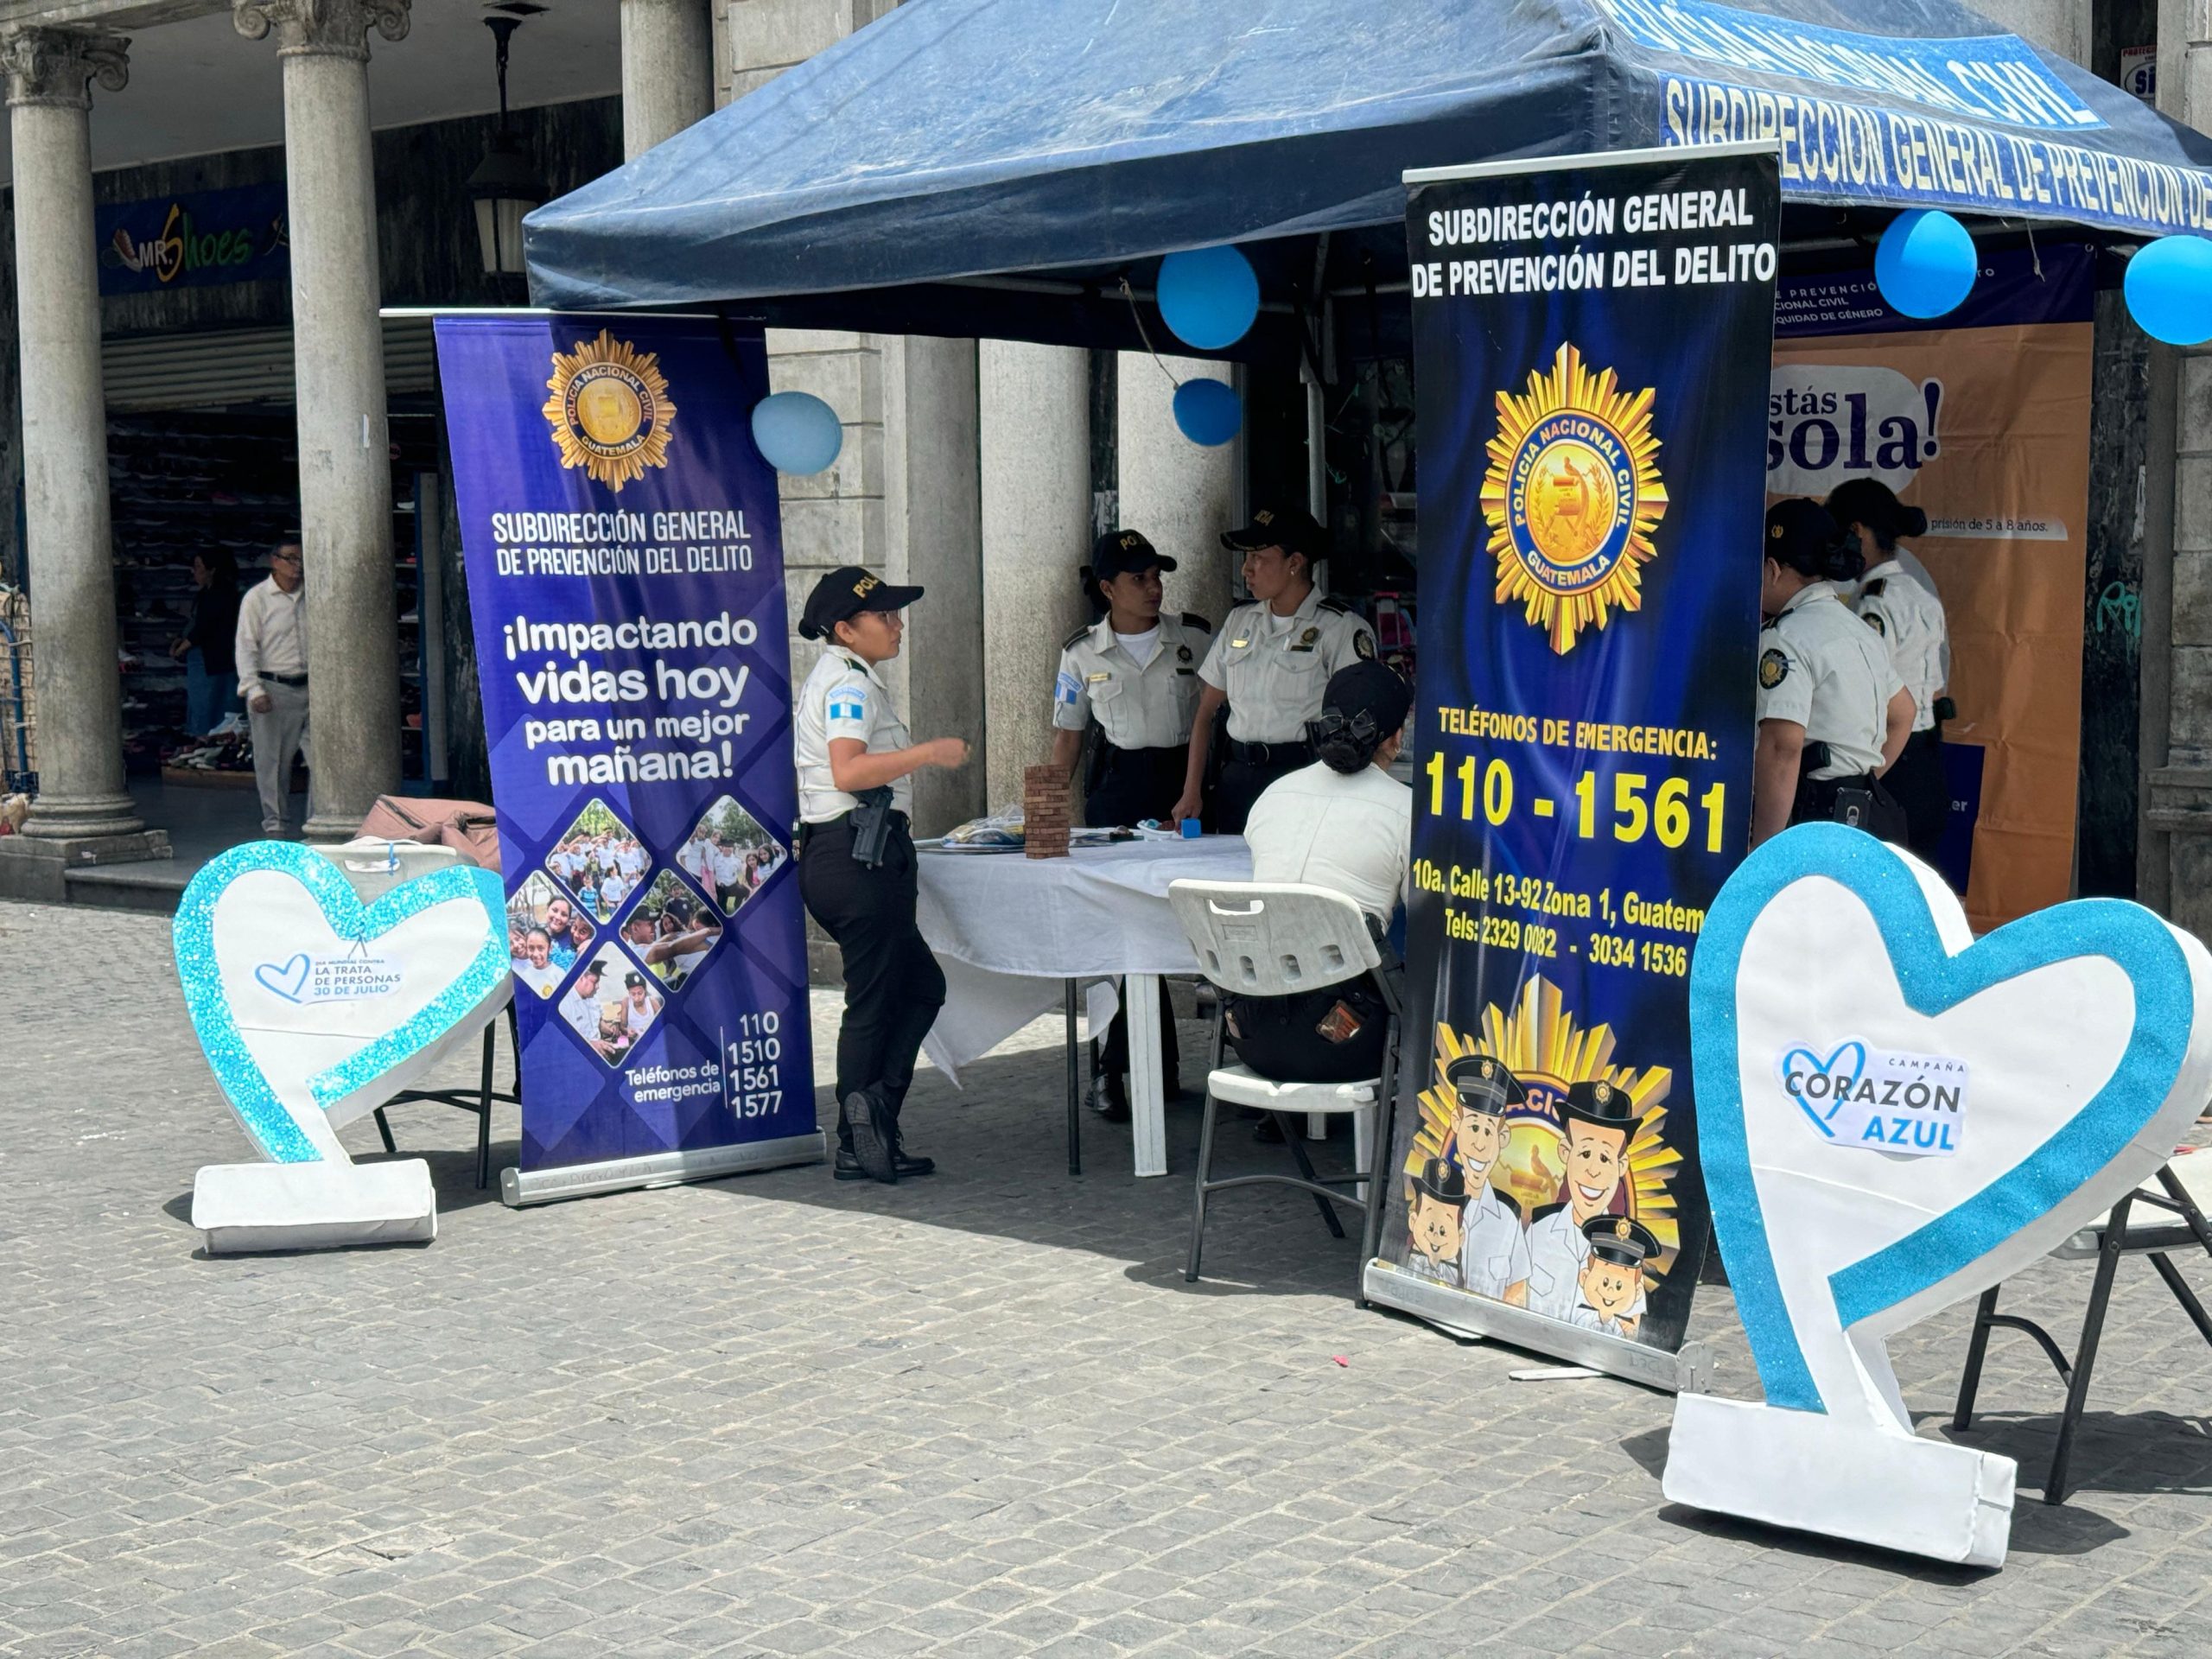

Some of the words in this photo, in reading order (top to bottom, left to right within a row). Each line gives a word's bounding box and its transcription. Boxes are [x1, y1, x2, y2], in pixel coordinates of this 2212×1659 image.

[1731, 22, 1997, 118] NACIONAL
[1946, 60, 2101, 124] CIVIL
[1666, 79, 1885, 184] SUBDIRECCION
[1887, 112, 2014, 200] GENERAL
[2011, 136, 2052, 204] DE
[2045, 143, 2185, 227] PREVENCION
[1428, 190, 1617, 246] SUBDIRECCIÓN
[1623, 188, 1754, 234] GENERAL
[139, 239, 173, 268] MR.
[156, 203, 253, 283] Shoes
[1411, 262, 1444, 298] DE
[1449, 245, 1605, 296] PREVENCIÓN
[1611, 248, 1667, 289] DEL
[1674, 243, 1777, 285] DELITO
[1775, 299, 1818, 311] CIONAL
[1818, 296, 1849, 308] CIVIL
[1789, 281, 1877, 298] PREVENCIÓ
[1775, 312, 1819, 325] QUIDAD
[1820, 311, 1837, 321] DE
[1837, 308, 1884, 320] GÉNERO
[567, 380, 585, 426] POLICIA
[582, 366, 640, 392] NACIONAL
[639, 390, 653, 423] CIVIL
[1770, 385, 1838, 416] stás
[582, 434, 645, 456] GUATEMALA
[1514, 441, 1541, 527] POLICIA
[1539, 419, 1621, 467] NACIONAL
[1615, 468, 1632, 528] CIVIL
[491, 509, 647, 543] SUBDIRECCIÓN
[653, 510, 752, 542] GENERAL
[1931, 518, 1966, 531] prisión
[1968, 518, 1983, 531] de
[1986, 519, 1993, 531] 5
[1996, 522, 2003, 531] a
[2006, 519, 2014, 531] 8
[2017, 520, 2049, 531] años.
[496, 548, 524, 575] DE
[528, 544, 640, 575] PREVENCIÓN
[645, 546, 683, 575] DEL
[686, 544, 753, 573] DELITO
[1527, 549, 1611, 588] GUATEMALA
[503, 611, 758, 661] ¡Impactando
[516, 660, 648, 704] vidas
[655, 658, 750, 708] hoy
[524, 718, 601, 750] para
[607, 717, 646, 741] un
[655, 709, 750, 743] mejor
[1438, 703, 1538, 744] TELÉFONOS
[1542, 720, 1570, 747] DE
[1574, 721, 1719, 760] EMERGENCIA:
[547, 740, 734, 786] mañana!
[1426, 751, 1514, 827] 110
[1533, 798, 1554, 818] -
[1574, 770, 1726, 854] 1561
[1413, 858, 1446, 893] 10a.
[1449, 864, 1489, 902] Calle
[1494, 872, 1542, 912] 13-92
[1541, 881, 1591, 918] Zona
[1599, 887, 1617, 929] 1,
[1445, 908, 1478, 940] Tels:
[1480, 918, 1521, 950] 2329
[1523, 926, 1557, 959] 0082
[1569, 943, 1578, 953] -
[1588, 932, 1635, 969] 3034
[1640, 940, 1688, 978] 1536
[314, 976, 330, 986] DE
[334, 974, 401, 985] PERSONAS
[315, 966, 331, 976] LA
[334, 965, 372, 976] TRATA
[314, 987, 331, 996] 30
[334, 986, 351, 995] DE
[353, 984, 390, 995] JULIO
[739, 1011, 780, 1037] 110
[728, 1037, 781, 1065] 1510
[1888, 1058, 1965, 1073] CAMPAÑA
[624, 1064, 698, 1087] Teléfonos
[700, 1059, 719, 1077] de
[633, 1077, 721, 1103] emergencia
[729, 1064, 779, 1092] 1561
[731, 1090, 783, 1119] 1577
[1784, 1071, 1961, 1113] CORAZÓN
[1861, 1116, 1955, 1151] AZUL
